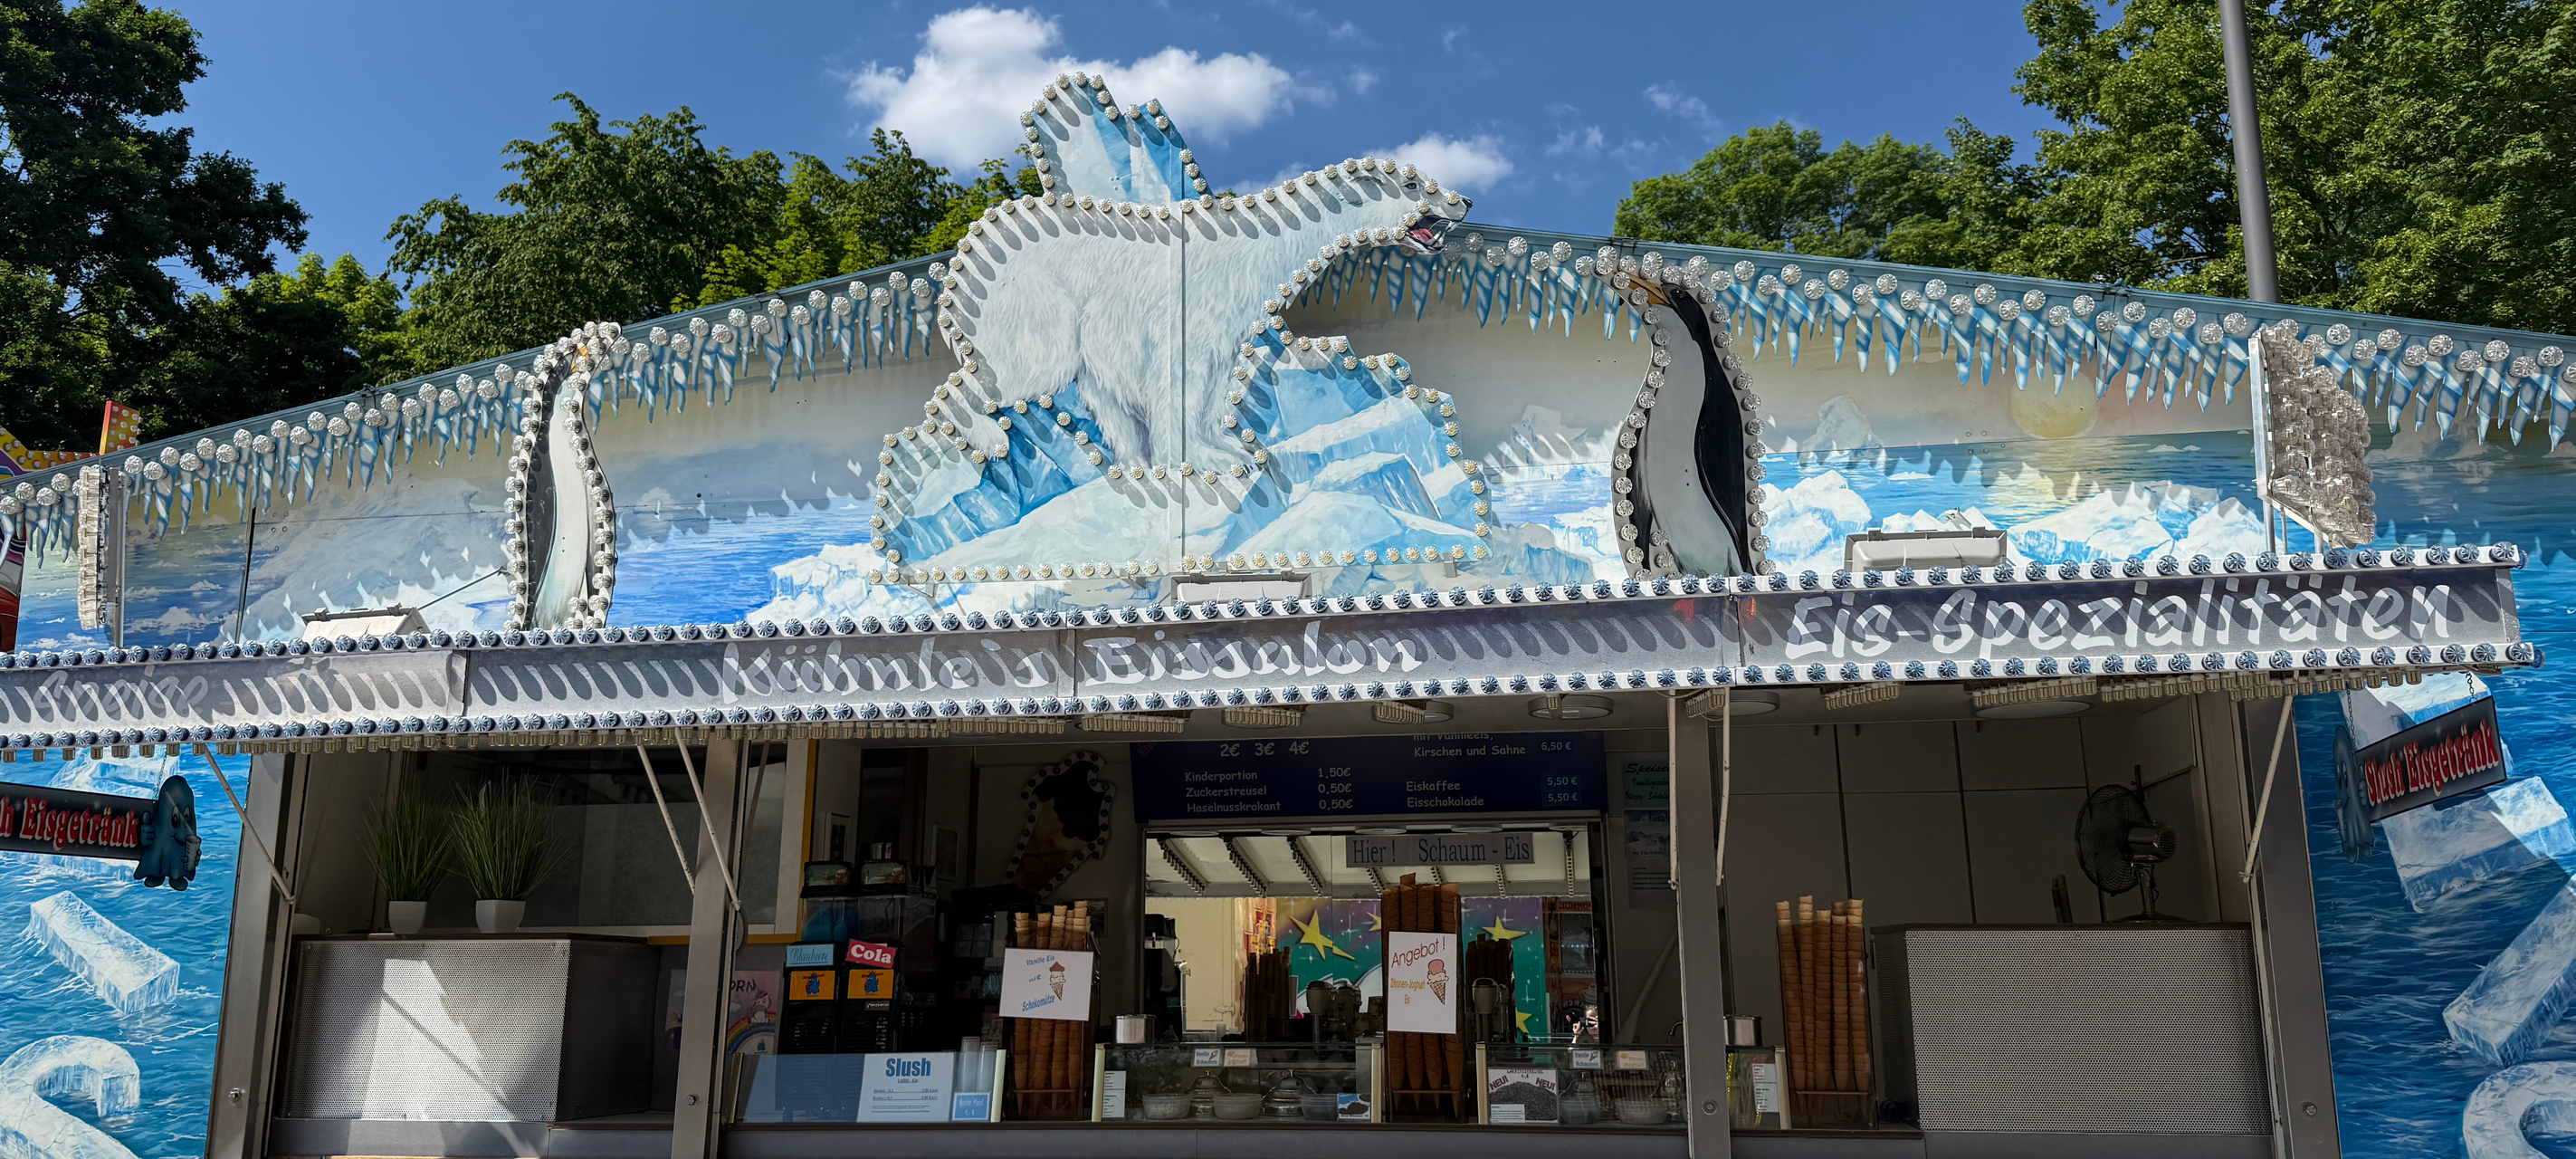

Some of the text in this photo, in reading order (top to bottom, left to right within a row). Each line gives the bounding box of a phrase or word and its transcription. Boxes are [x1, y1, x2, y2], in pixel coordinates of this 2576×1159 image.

[1785, 573, 2450, 660] Eis-Spezialitäten
[1083, 620, 1424, 686] Eissalon
[1220, 741, 1310, 757] 2€ 3€ 4€
[1414, 741, 1572, 758] Kirschen und Sahne 6,50 €
[2364, 715, 2499, 806] Slush Eisgetränk
[1185, 768, 1351, 783] Kinderportion 1,50€
[1406, 776, 1578, 792] Eiskaffee 5,50 €
[1186, 783, 1352, 798] Zuckerstreusel 0,50€
[1188, 799, 1353, 813] Haselnusskrokant 0,50€
[1407, 792, 1579, 808] Eisschokolade 5,50 €
[19, 796, 138, 851] Eisgetränk
[1352, 838, 1386, 864] Hier
[1418, 838, 1486, 862] Schaum
[1504, 836, 1530, 860] Eis
[851, 943, 892, 963] Cola
[1391, 938, 1439, 968] Angebot
[885, 1058, 931, 1078] Slush
[1489, 1075, 1509, 1090] NEU!
[1536, 1078, 1556, 1090] NEU!
